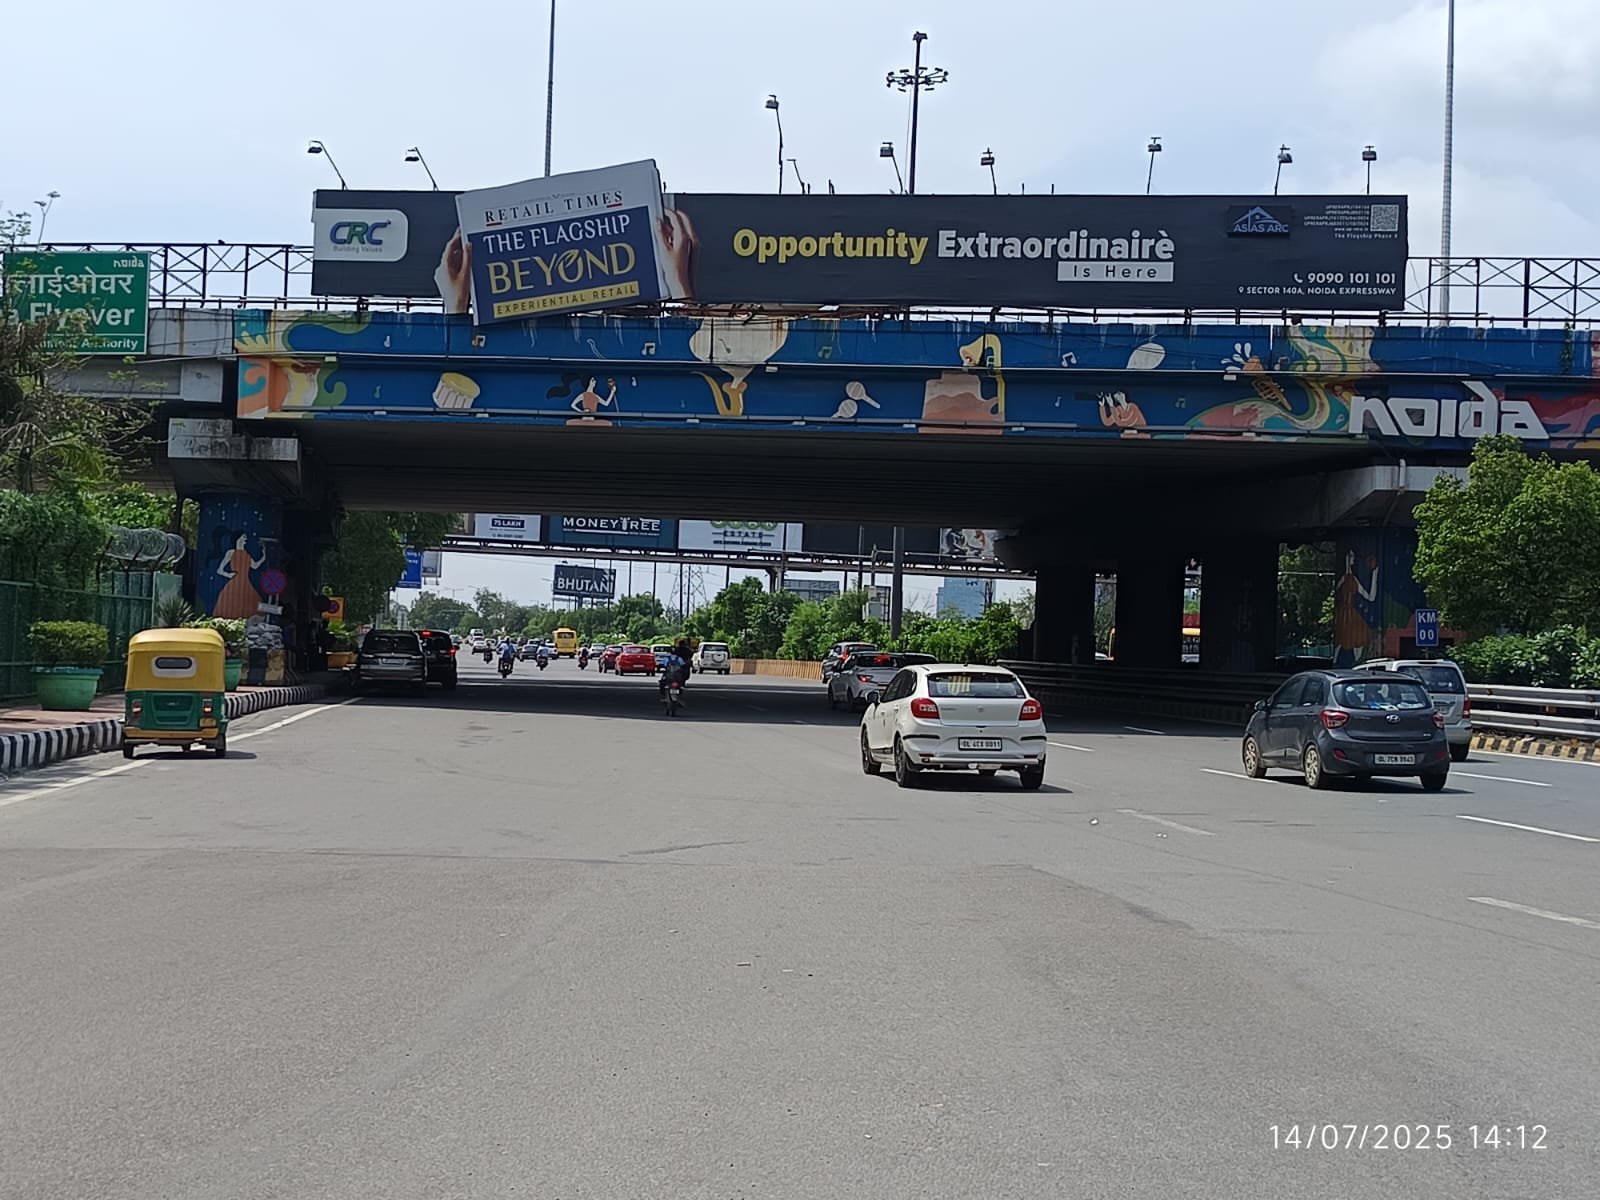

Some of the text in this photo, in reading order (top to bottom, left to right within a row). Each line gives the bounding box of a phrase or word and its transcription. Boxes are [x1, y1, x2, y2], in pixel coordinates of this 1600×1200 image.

[485, 202, 554, 222] RETAIL
[564, 190, 623, 210] TIMES
[330, 221, 390, 245] CRC
[483, 214, 631, 254] THE FLAGSHIP
[1266, 223, 1289, 233] ARC
[733, 228, 1175, 265] Opportunity Extraordinairè
[113, 255, 145, 268] noida
[486, 243, 636, 294] BEYOND
[1073, 264, 1158, 278] Is Here
[1307, 272, 1396, 284] 9090 101 101
[497, 285, 636, 314] EXPERIENTIAL RETAIL
[1246, 286, 1397, 296] SECTOR 140A, NOIDA EXPRESSWAY
[1348, 380, 1550, 440] noida
[557, 577, 614, 594] BHUTANI
[1418, 612, 1436, 623] KM
[1419, 629, 1435, 640] 00
